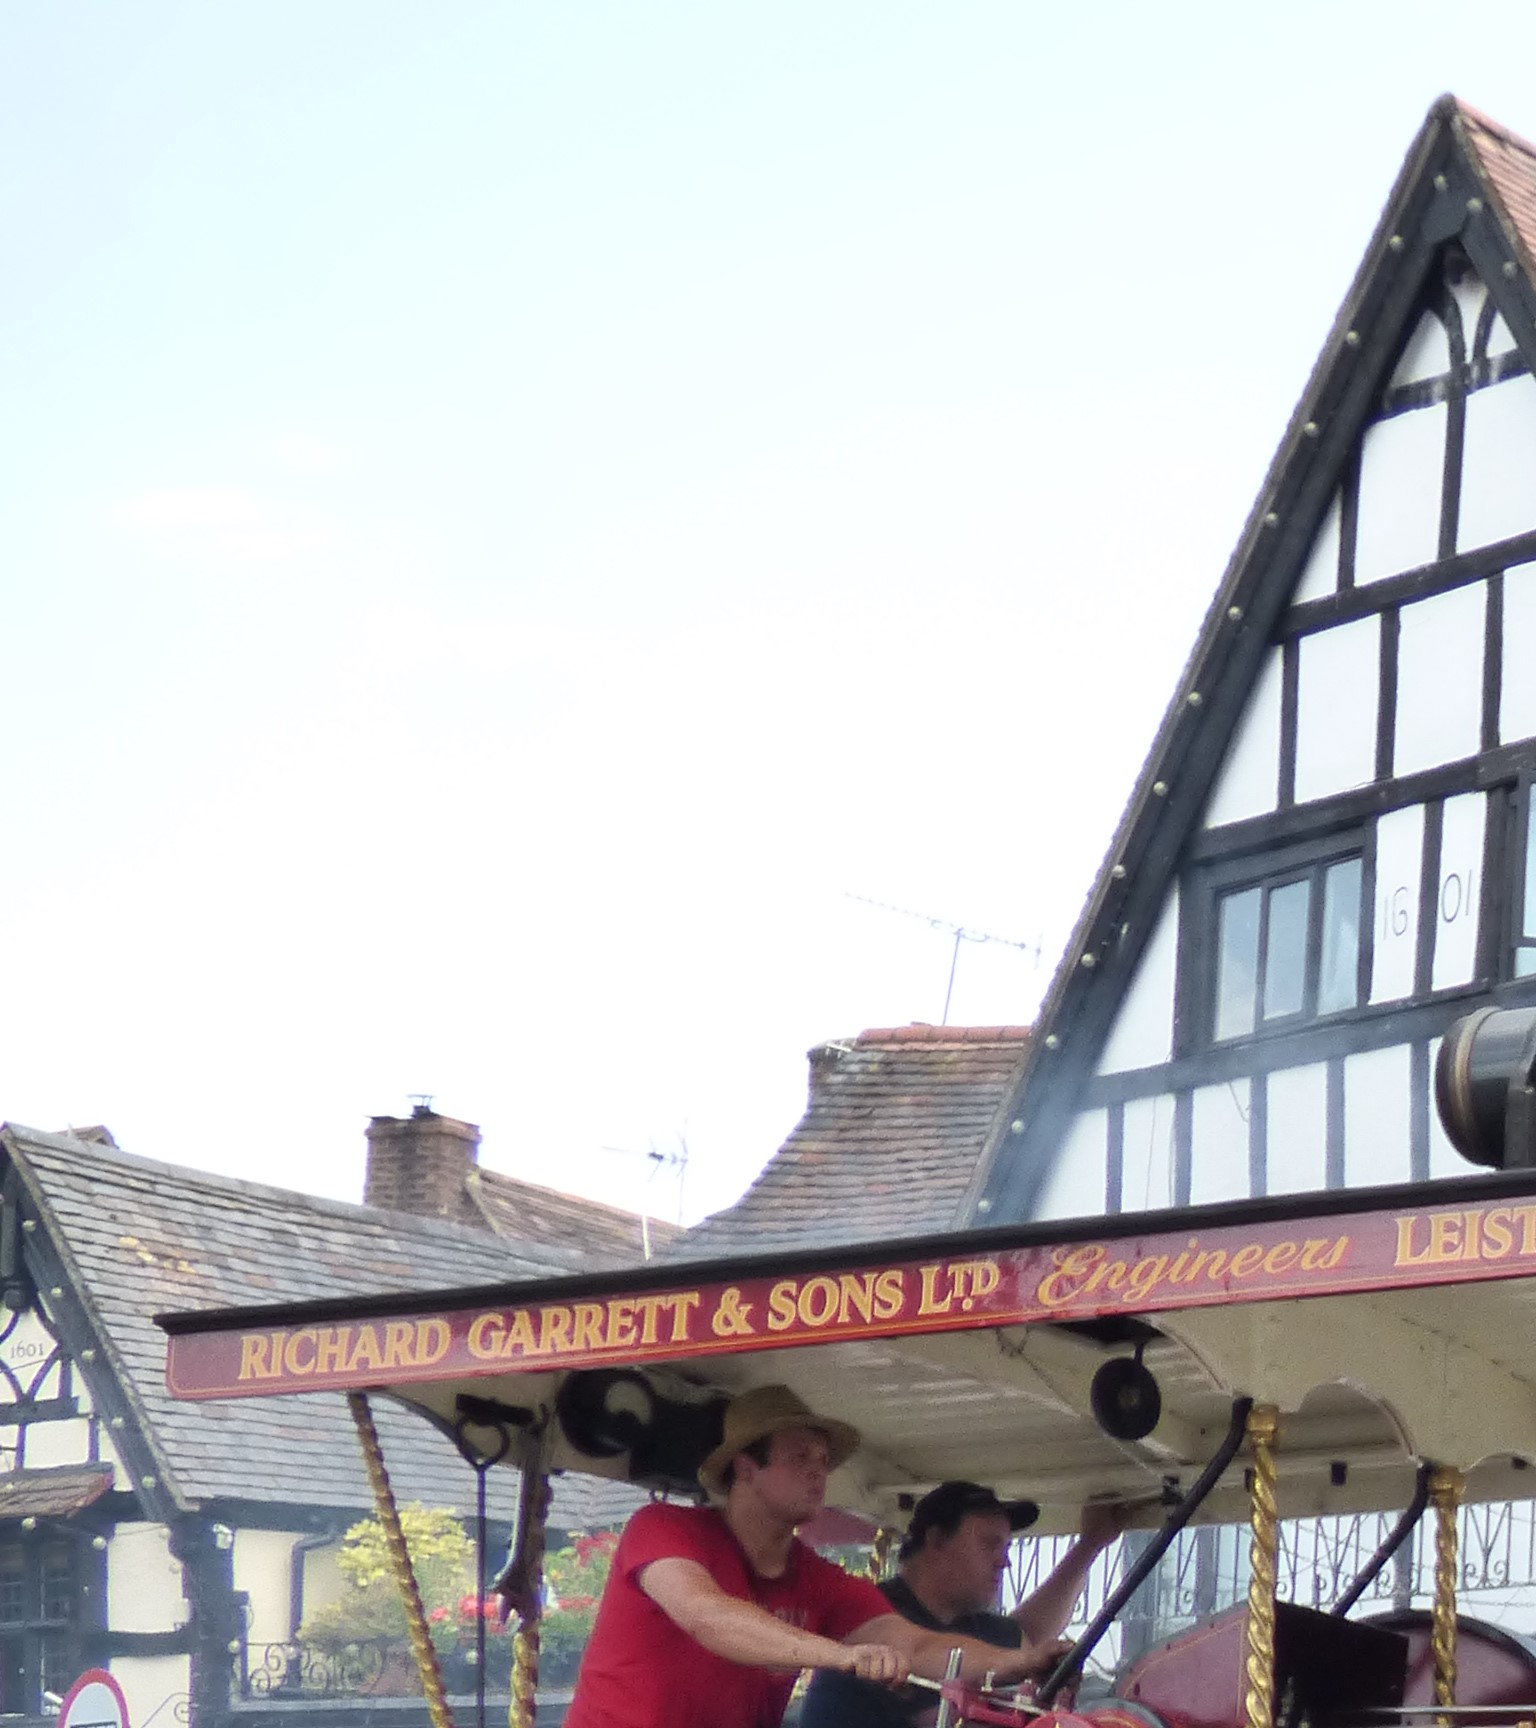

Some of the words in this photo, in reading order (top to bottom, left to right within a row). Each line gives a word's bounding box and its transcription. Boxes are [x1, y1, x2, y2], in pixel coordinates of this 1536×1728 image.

[1037, 1234, 1350, 1309] Engineers
[10, 1340, 44, 1359] 1601
[238, 1319, 451, 1380] RICHARD
[468, 1291, 699, 1360] GARRETT
[711, 1286, 755, 1336] &
[767, 1269, 903, 1330] SONS
